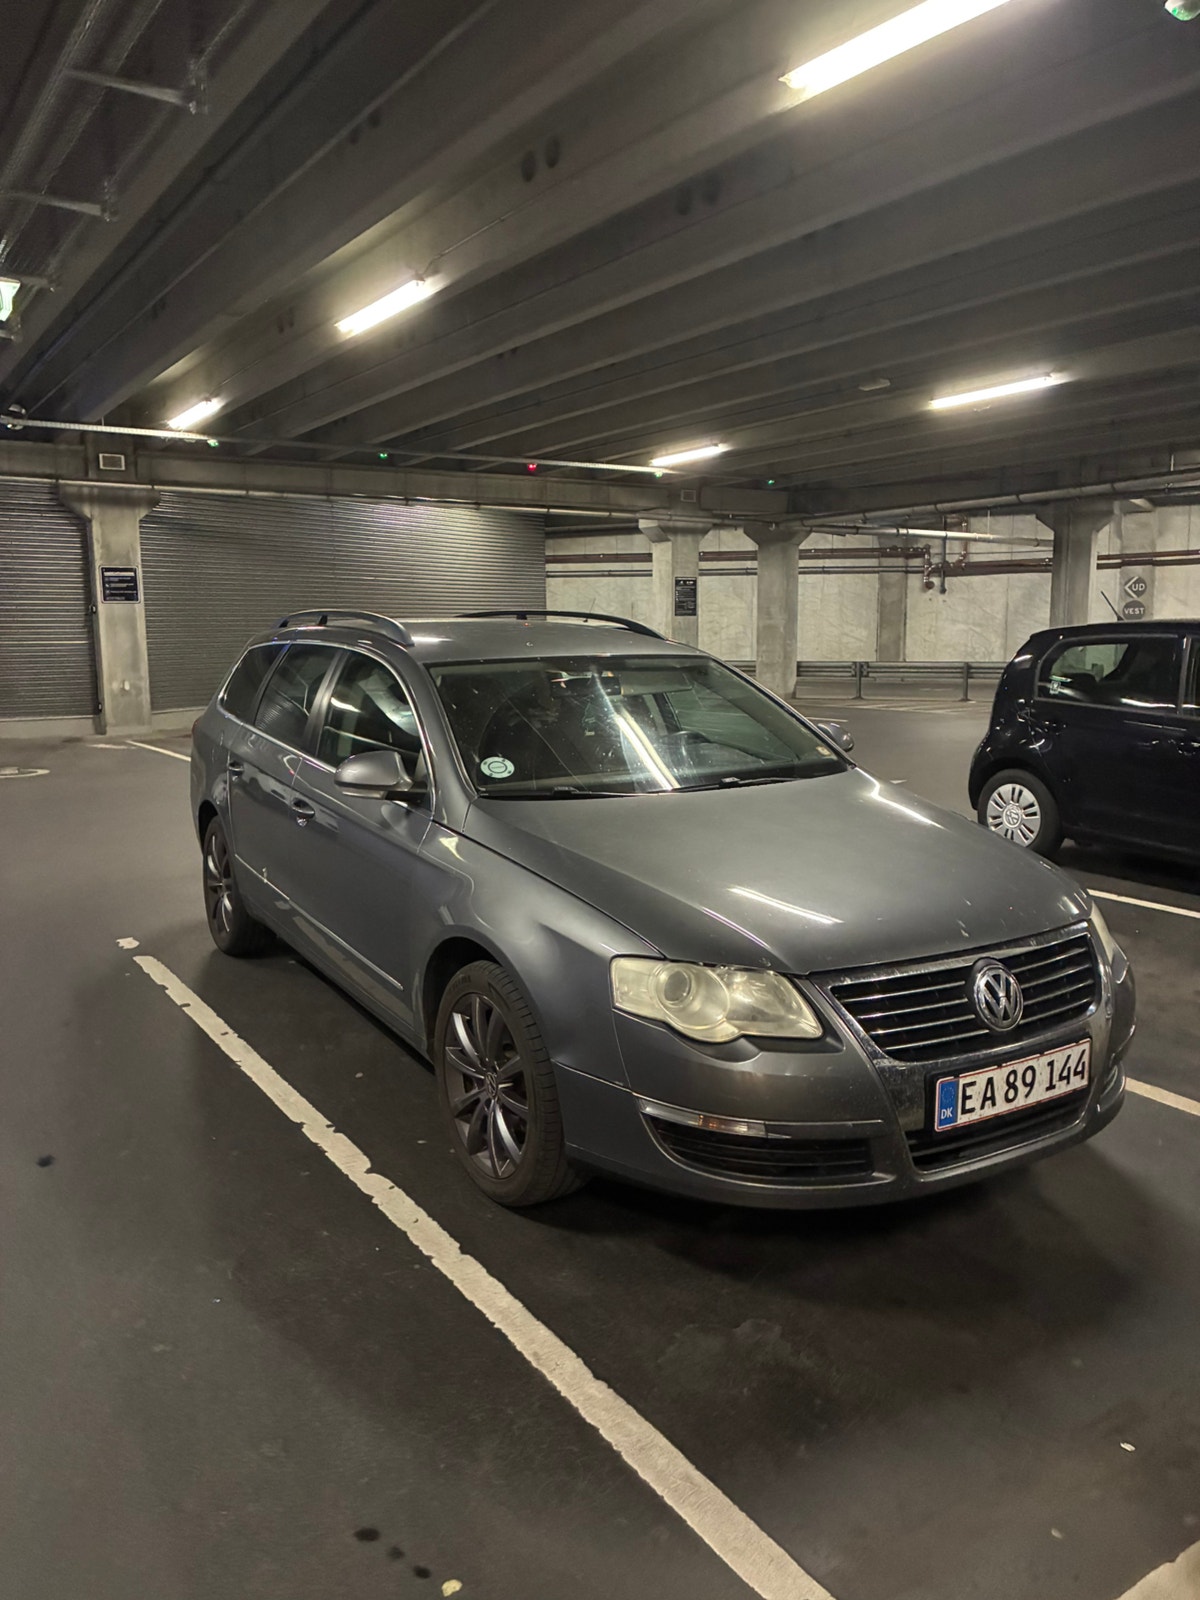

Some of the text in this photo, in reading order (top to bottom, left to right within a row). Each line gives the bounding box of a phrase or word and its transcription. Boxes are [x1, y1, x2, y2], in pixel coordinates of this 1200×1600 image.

[1132, 583, 1145, 591] UD
[961, 1049, 1086, 1115] EA 89 144
[941, 1107, 953, 1119] DK
